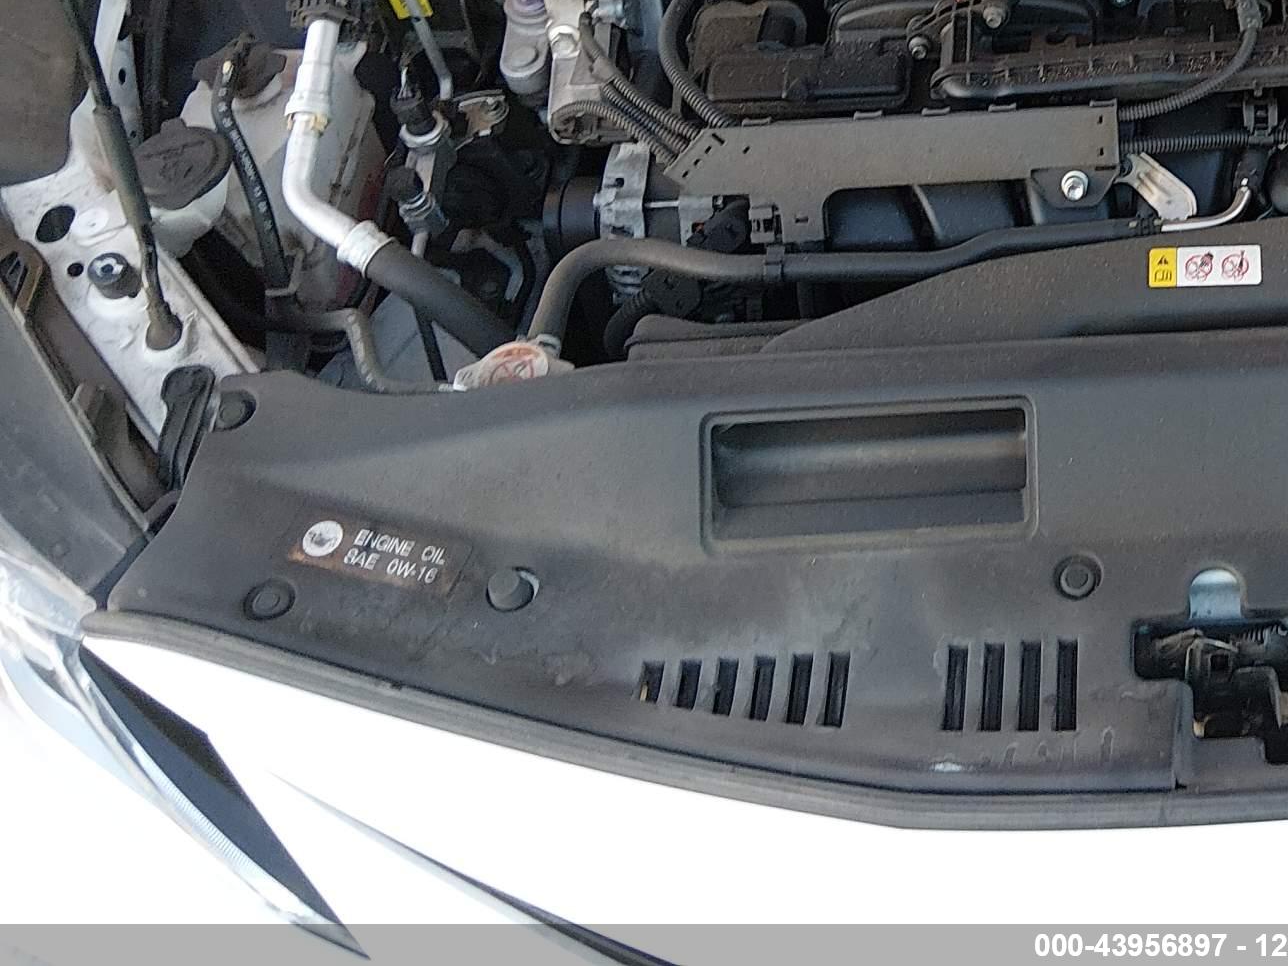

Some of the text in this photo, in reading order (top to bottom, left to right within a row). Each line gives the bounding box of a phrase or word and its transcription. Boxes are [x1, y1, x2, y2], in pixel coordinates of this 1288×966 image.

[344, 547, 439, 584] SAE 0W-16
[353, 529, 446, 566] ENGINE OIL
